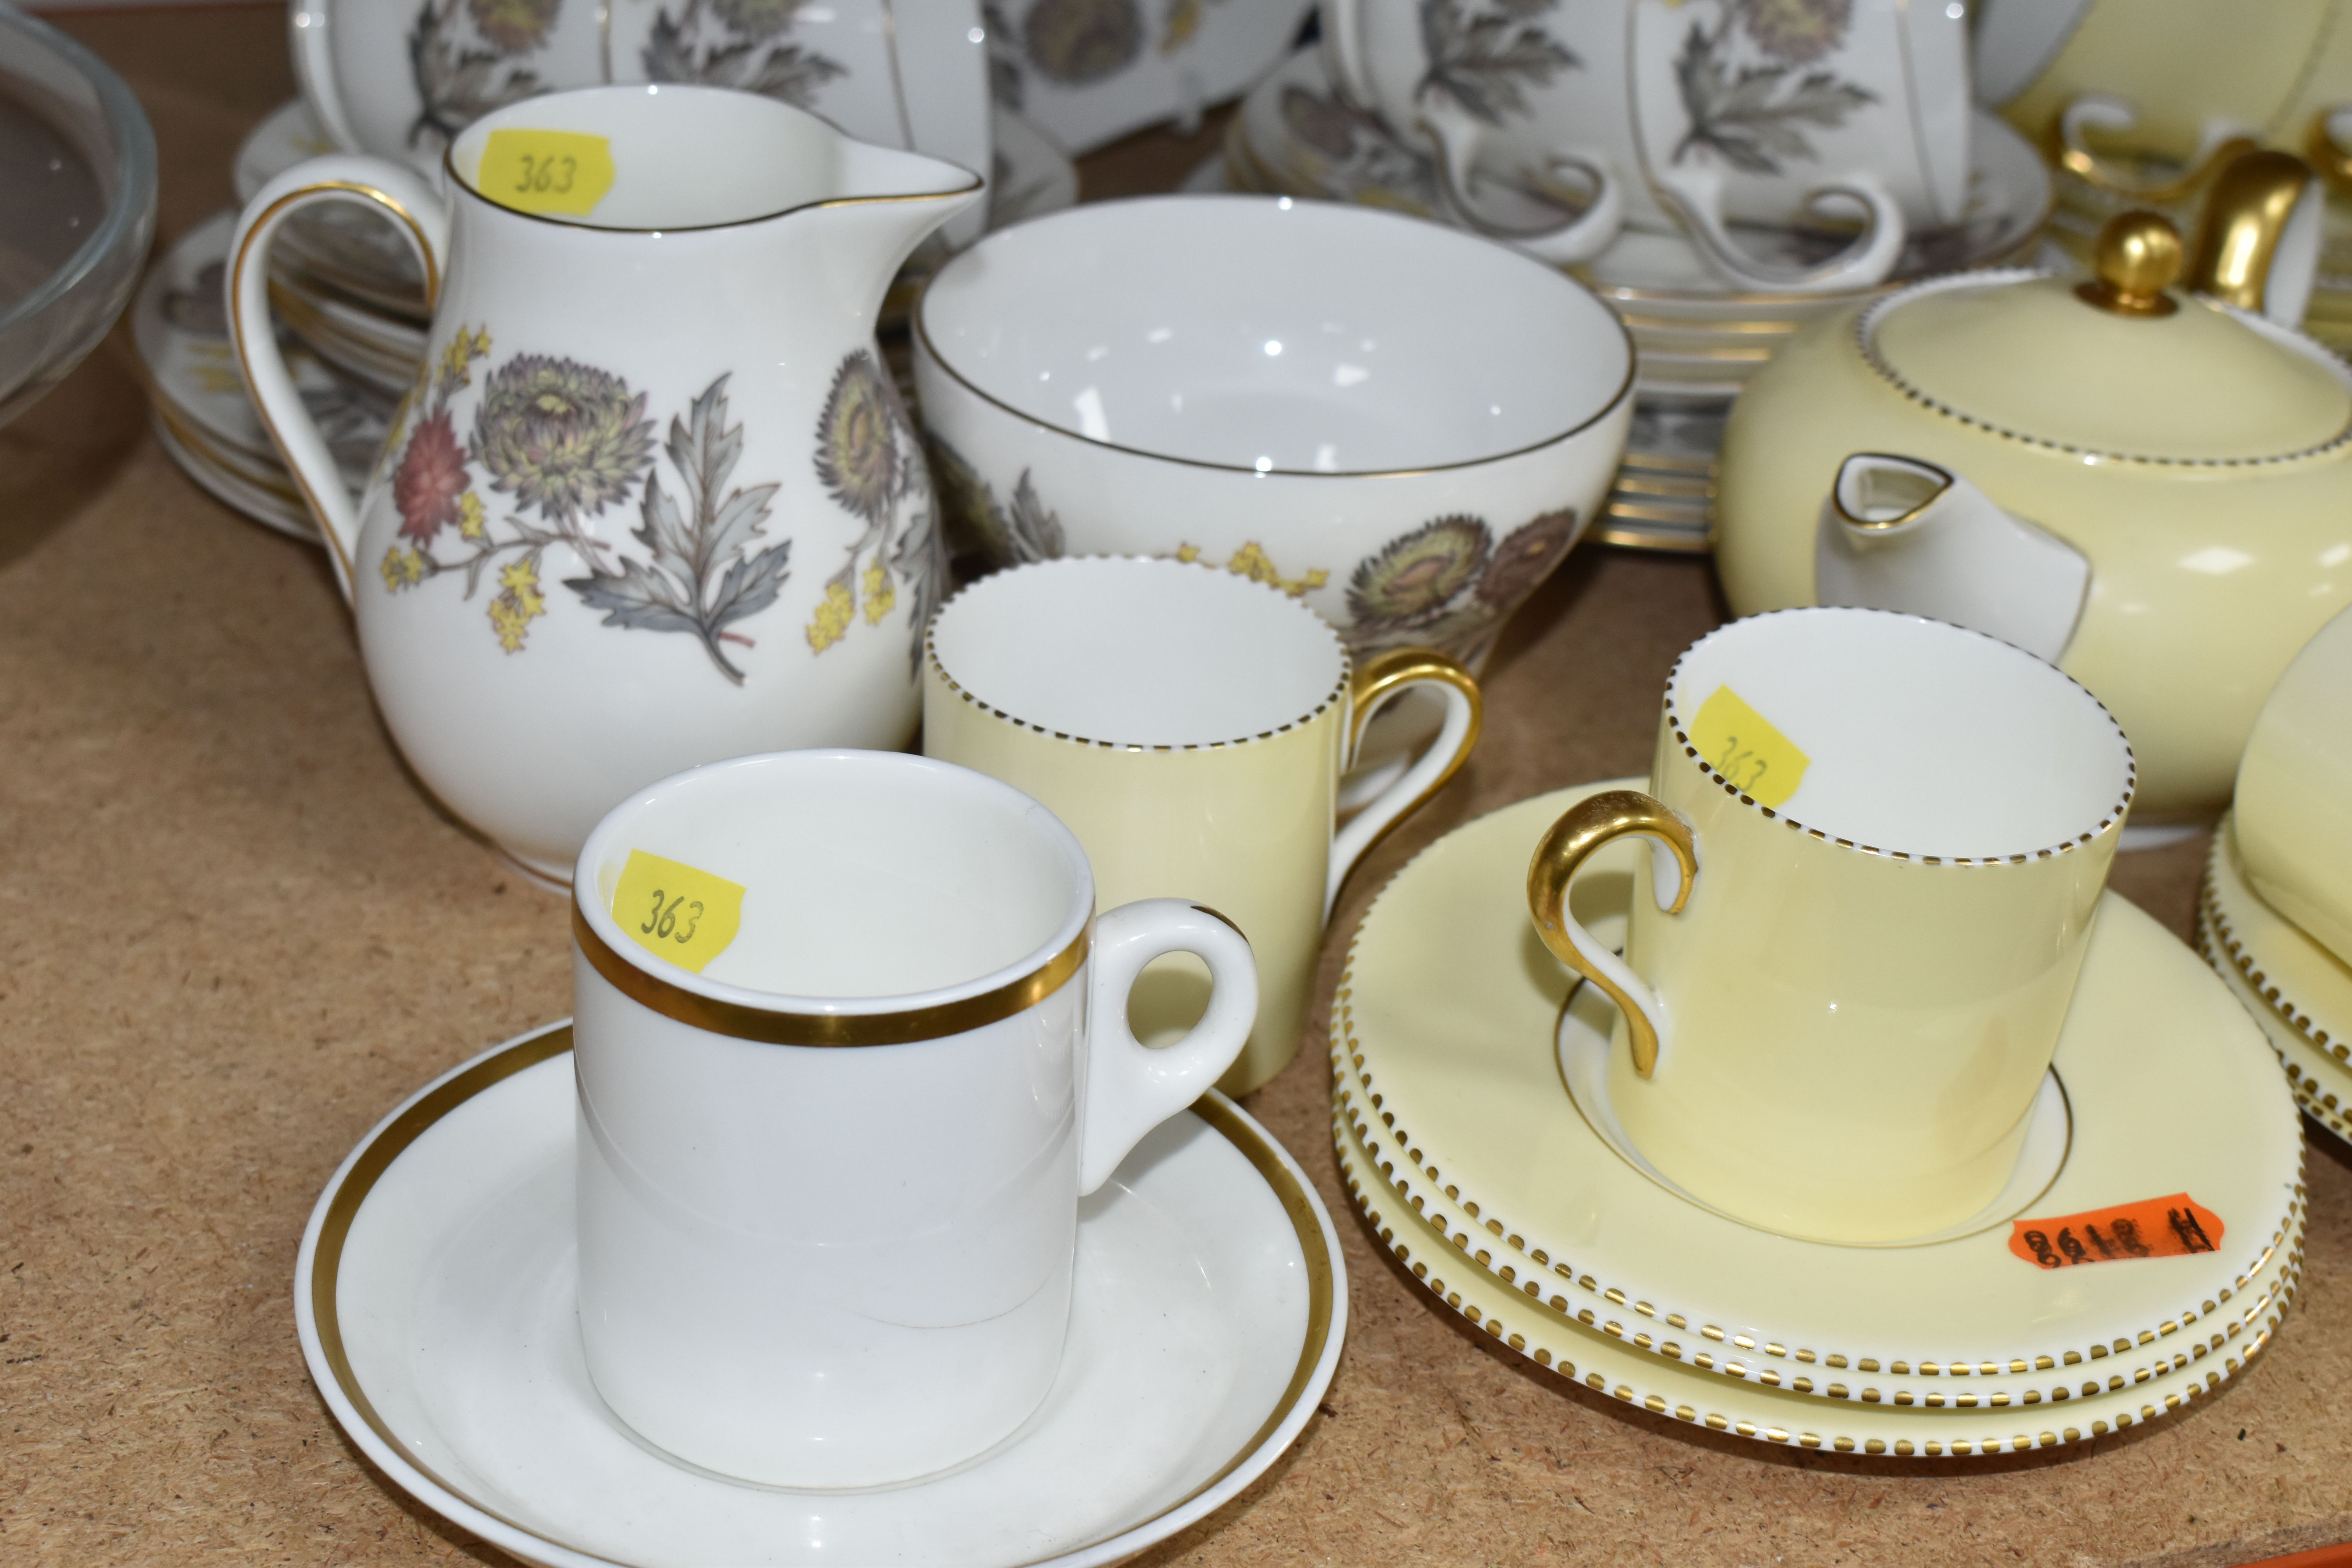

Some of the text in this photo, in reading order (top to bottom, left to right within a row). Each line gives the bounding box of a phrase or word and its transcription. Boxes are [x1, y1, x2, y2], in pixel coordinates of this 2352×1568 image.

[515, 155, 577, 194] 363
[1710, 736, 1768, 793] 363
[641, 889, 704, 944] 363
